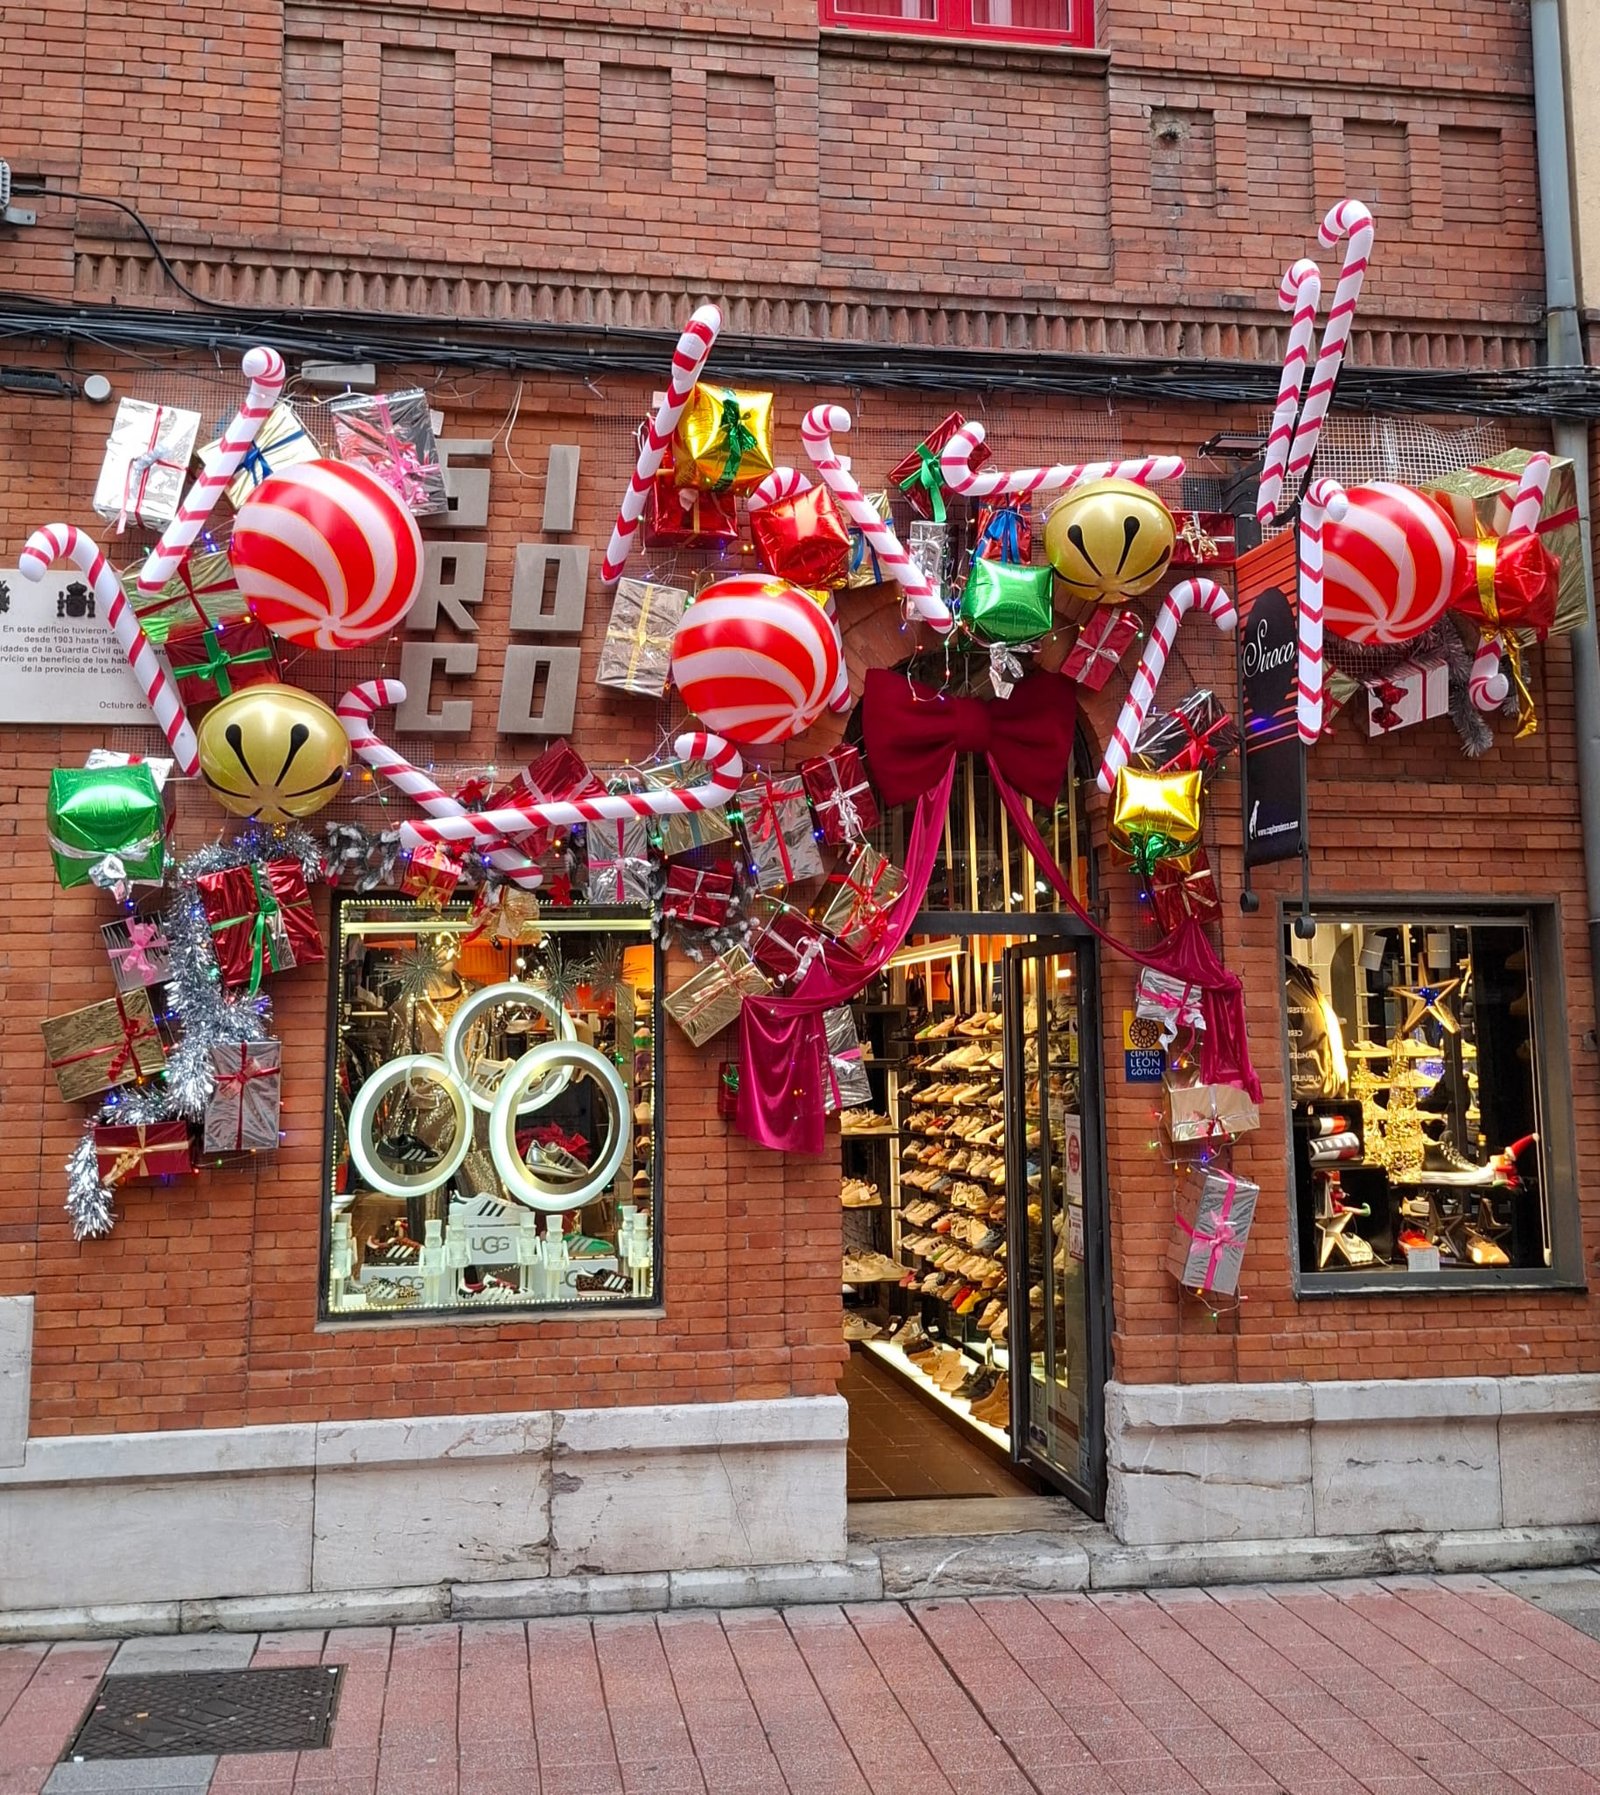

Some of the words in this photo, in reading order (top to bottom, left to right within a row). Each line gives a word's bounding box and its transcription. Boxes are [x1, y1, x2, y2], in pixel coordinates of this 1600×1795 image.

[2, 625, 15, 633] En
[37, 626, 70, 634] edificio
[71, 626, 108, 634] tuvieron
[53, 636, 73, 644] 1903
[55, 645, 89, 654] Guardia
[91, 647, 112, 655] Civil
[113, 648, 125, 656] qu
[1243, 618, 1295, 678] Siroco
[40, 655, 81, 664] beneficio
[82, 656, 94, 664] de
[95, 656, 109, 664] los
[21, 665, 33, 673] de
[45, 665, 85, 674] provincia
[87, 666, 99, 674] de
[99, 701, 135, 710] Octubre
[136, 702, 148, 710] de
[1130, 1050, 1160, 1058] CENTRO
[1130, 1057, 1160, 1068] LEÓN
[1131, 1067, 1161, 1076] GÓTICO
[471, 1235, 510, 1254] UGG
[394, 1275, 425, 1292] GG
